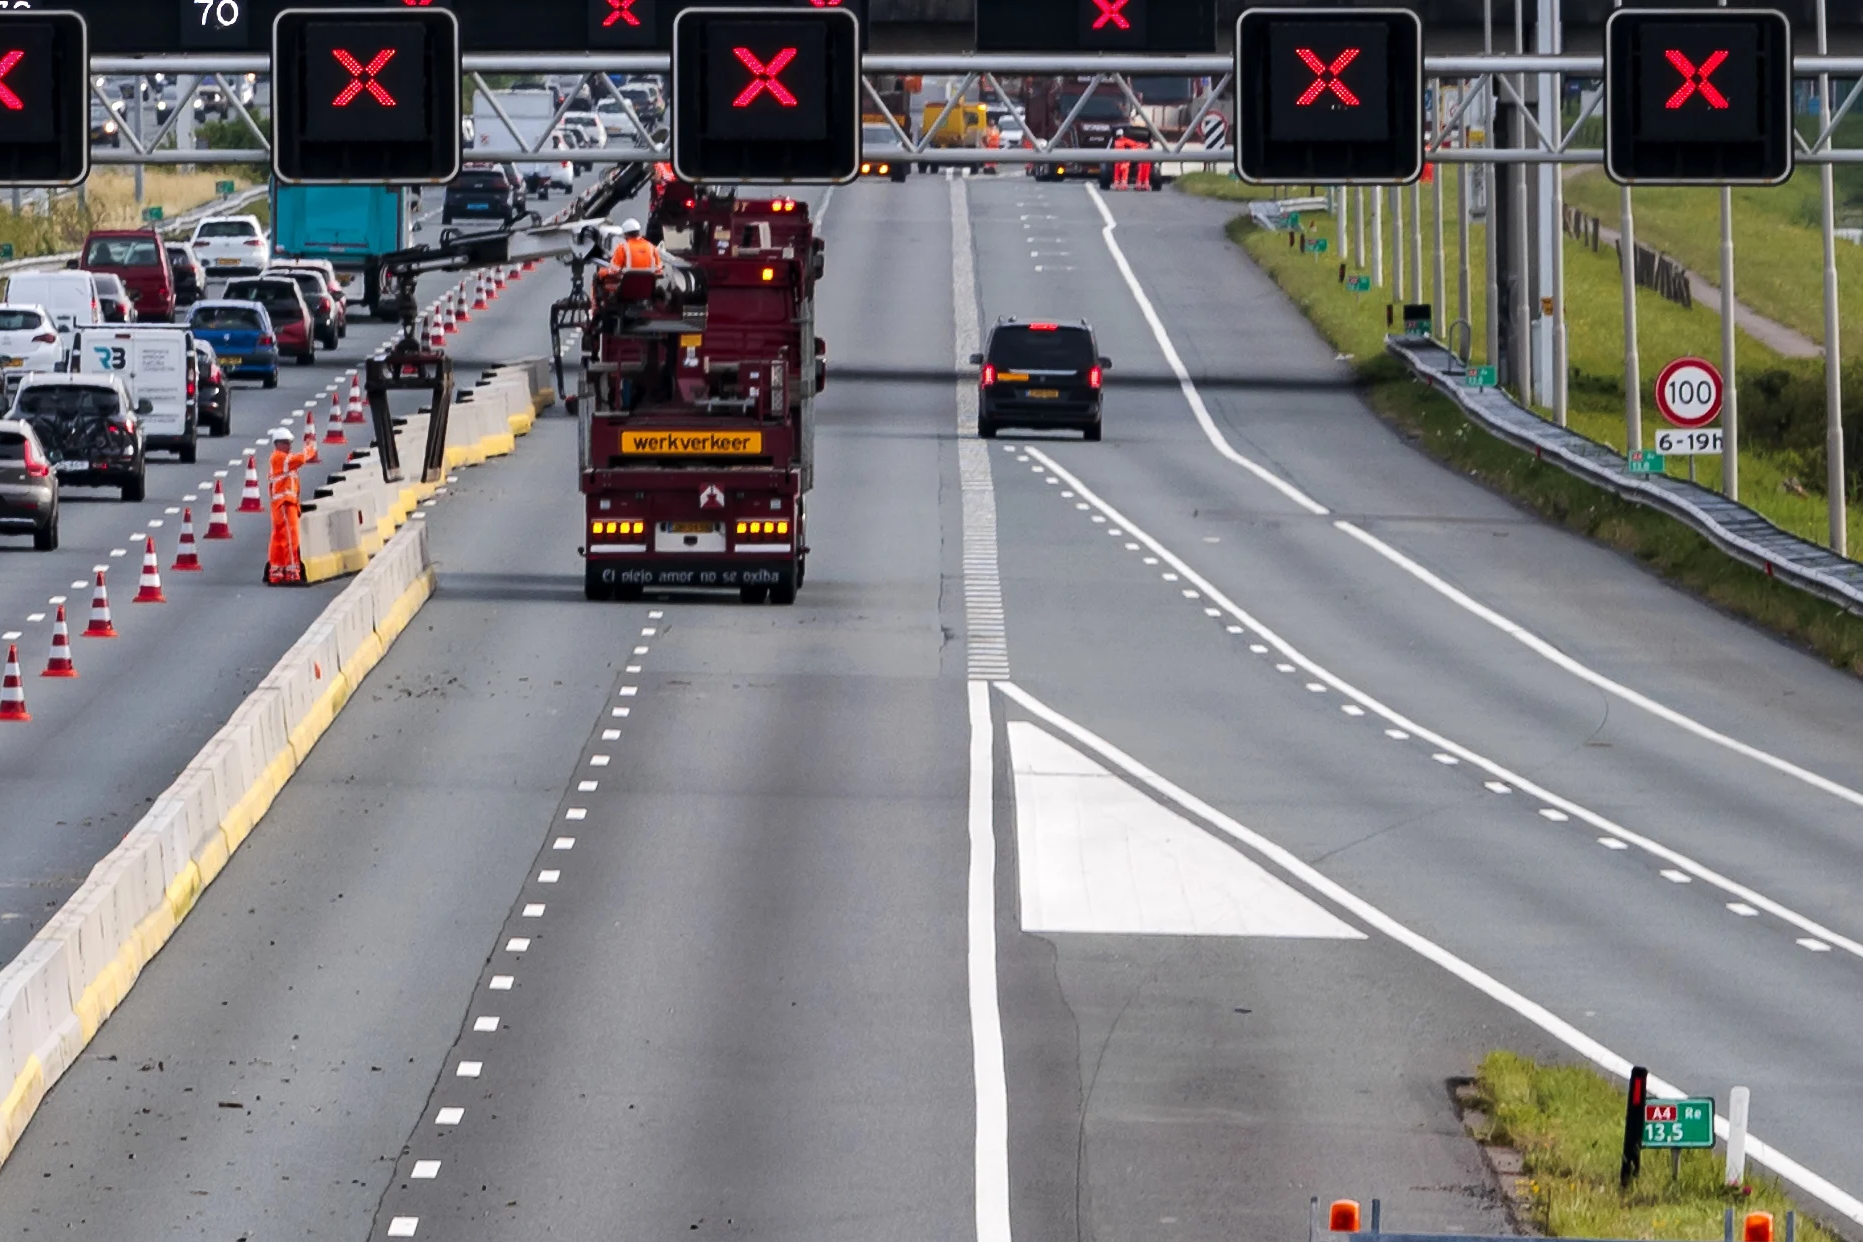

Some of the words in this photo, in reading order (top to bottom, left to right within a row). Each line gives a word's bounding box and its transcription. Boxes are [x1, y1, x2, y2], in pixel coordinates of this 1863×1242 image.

[193, 0, 239, 26] 70
[1668, 380, 1712, 405] 100
[633, 433, 751, 452] werkverkeer
[1658, 432, 1723, 451] 6-19h
[1652, 1107, 1672, 1120] A4
[1685, 1107, 1702, 1120] Re
[1645, 1123, 1684, 1142] 13,5
